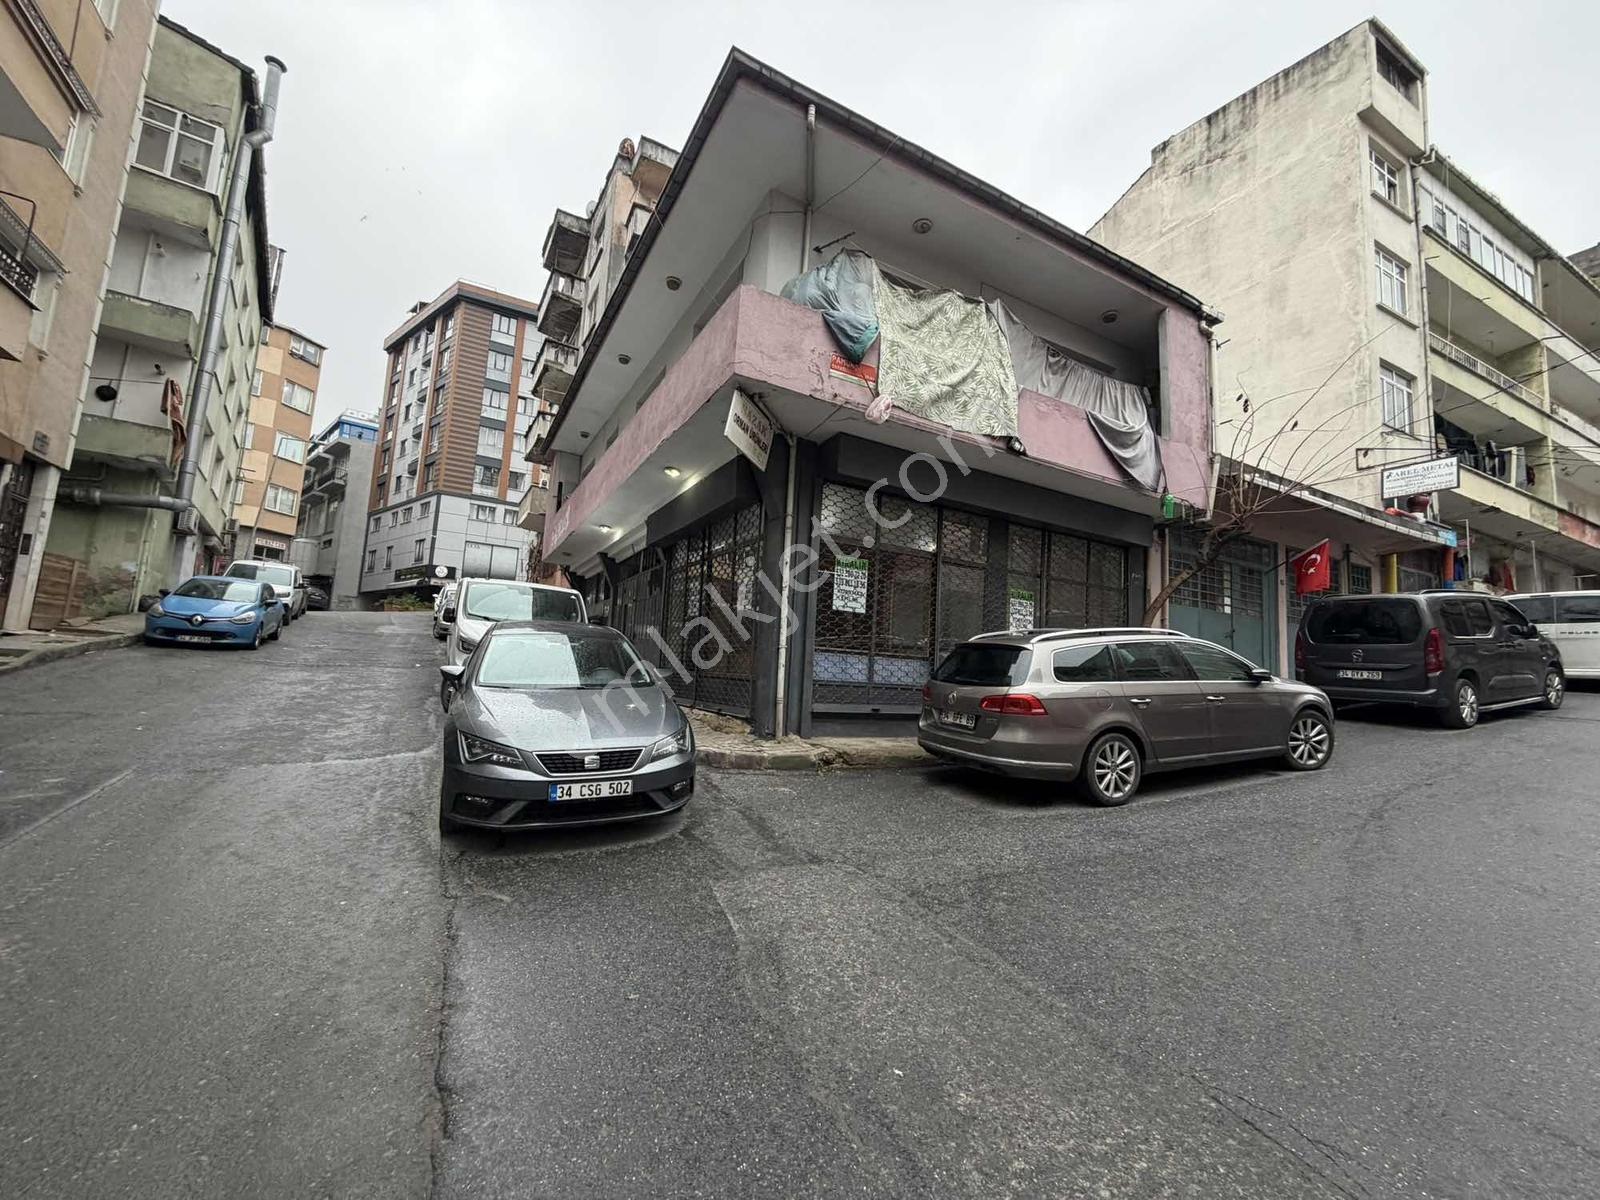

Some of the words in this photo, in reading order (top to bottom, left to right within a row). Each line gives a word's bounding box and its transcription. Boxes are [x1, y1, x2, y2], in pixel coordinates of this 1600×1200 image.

[558, 785, 572, 799] 34
[580, 783, 602, 797] CSG
[608, 781, 630, 795] 502
